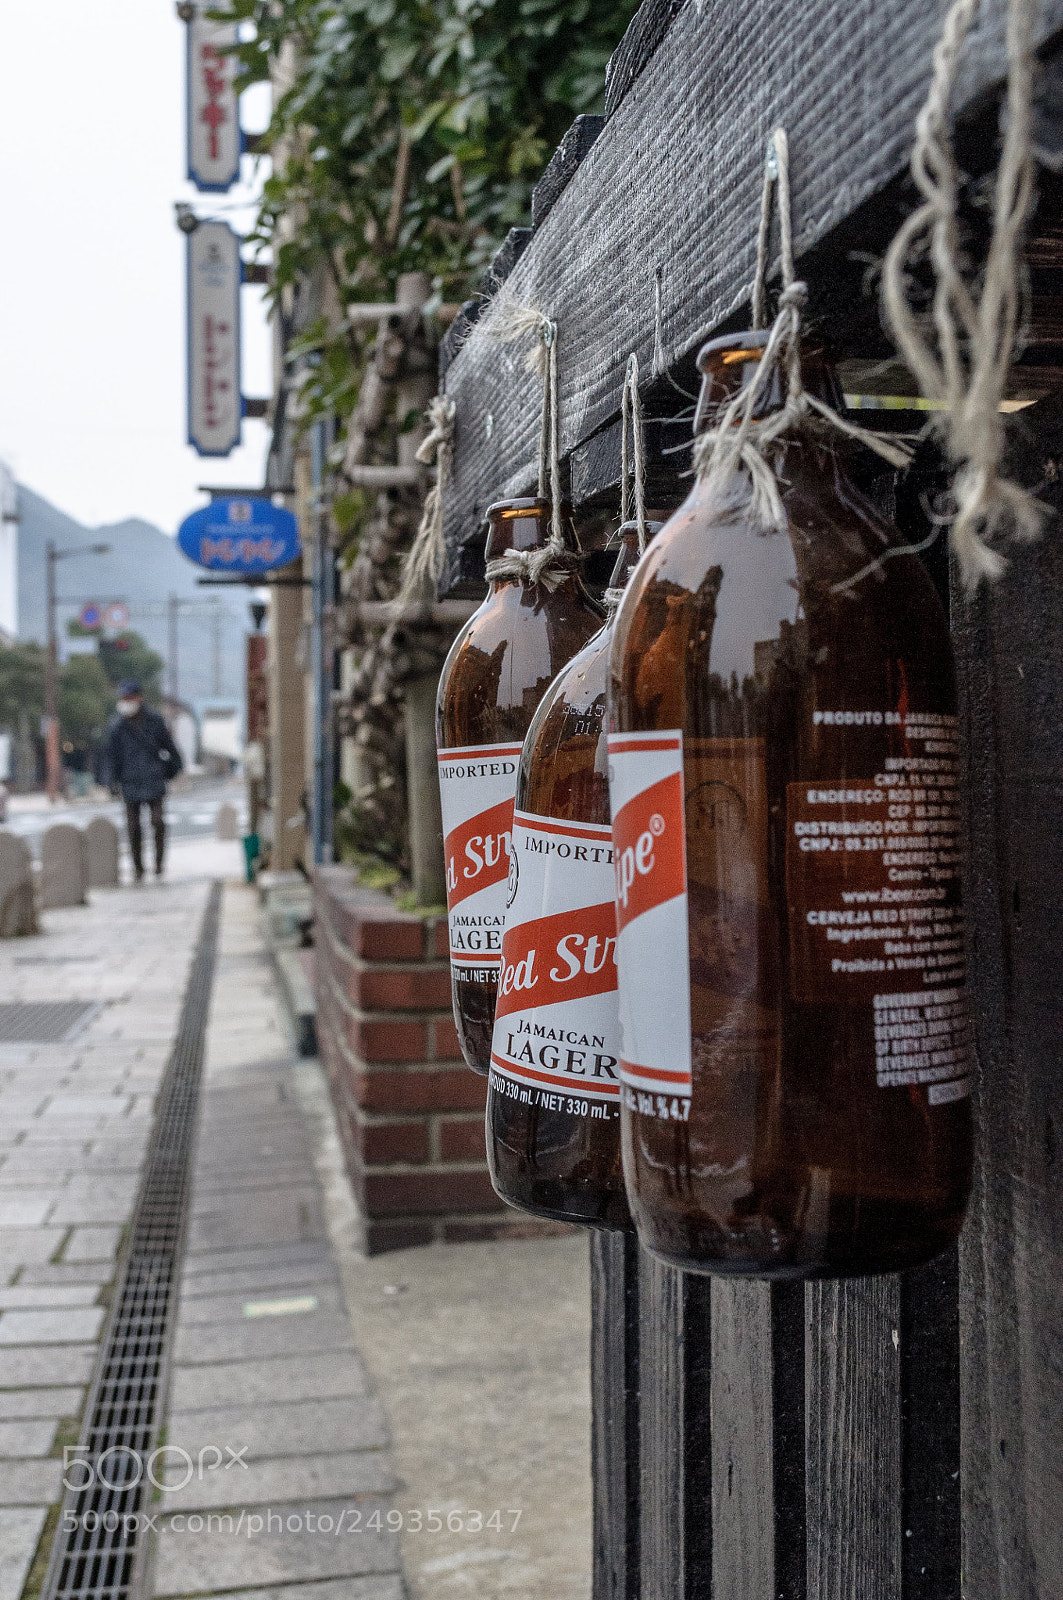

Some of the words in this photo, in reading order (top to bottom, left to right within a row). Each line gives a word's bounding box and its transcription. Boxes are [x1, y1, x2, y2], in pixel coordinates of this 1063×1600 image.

[813, 711, 883, 725] PRODUTO
[807, 910, 872, 925] CERVEJA
[473, 970, 490, 983] NET
[517, 1019, 606, 1049] JAMAICAN
[505, 1033, 619, 1080] LAGER
[505, 1081, 519, 1100] 330
[540, 1092, 565, 1112] NET
[566, 1098, 589, 1117] 330
[590, 1104, 611, 1120] mL
[670, 1098, 692, 1121] 4.7
